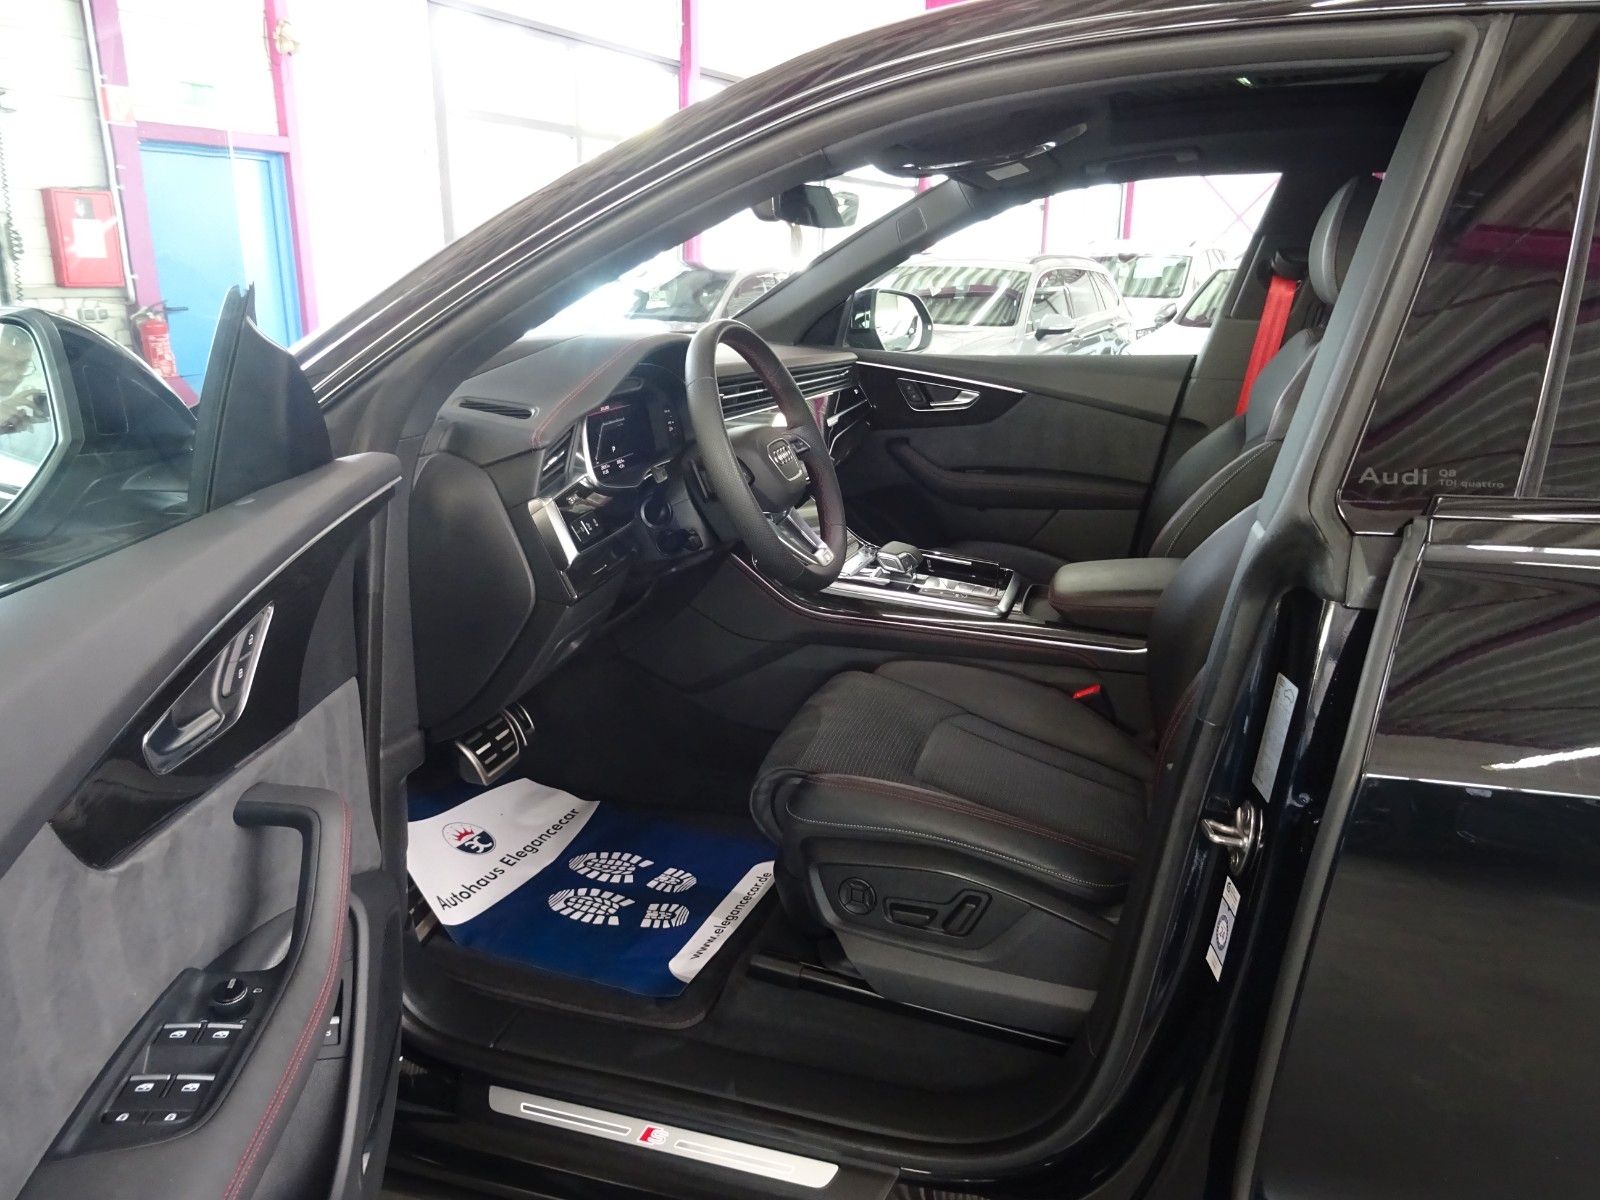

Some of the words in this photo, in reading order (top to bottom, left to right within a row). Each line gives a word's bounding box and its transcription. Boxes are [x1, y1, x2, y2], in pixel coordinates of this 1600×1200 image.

[1358, 466, 1428, 486] Audi
[1439, 469, 1457, 478] Q8
[1460, 480, 1505, 489] quattro
[436, 866, 505, 911] Autohaus
[499, 808, 580, 867] Elegancecar
[690, 872, 772, 960] www.elegancecar.de
